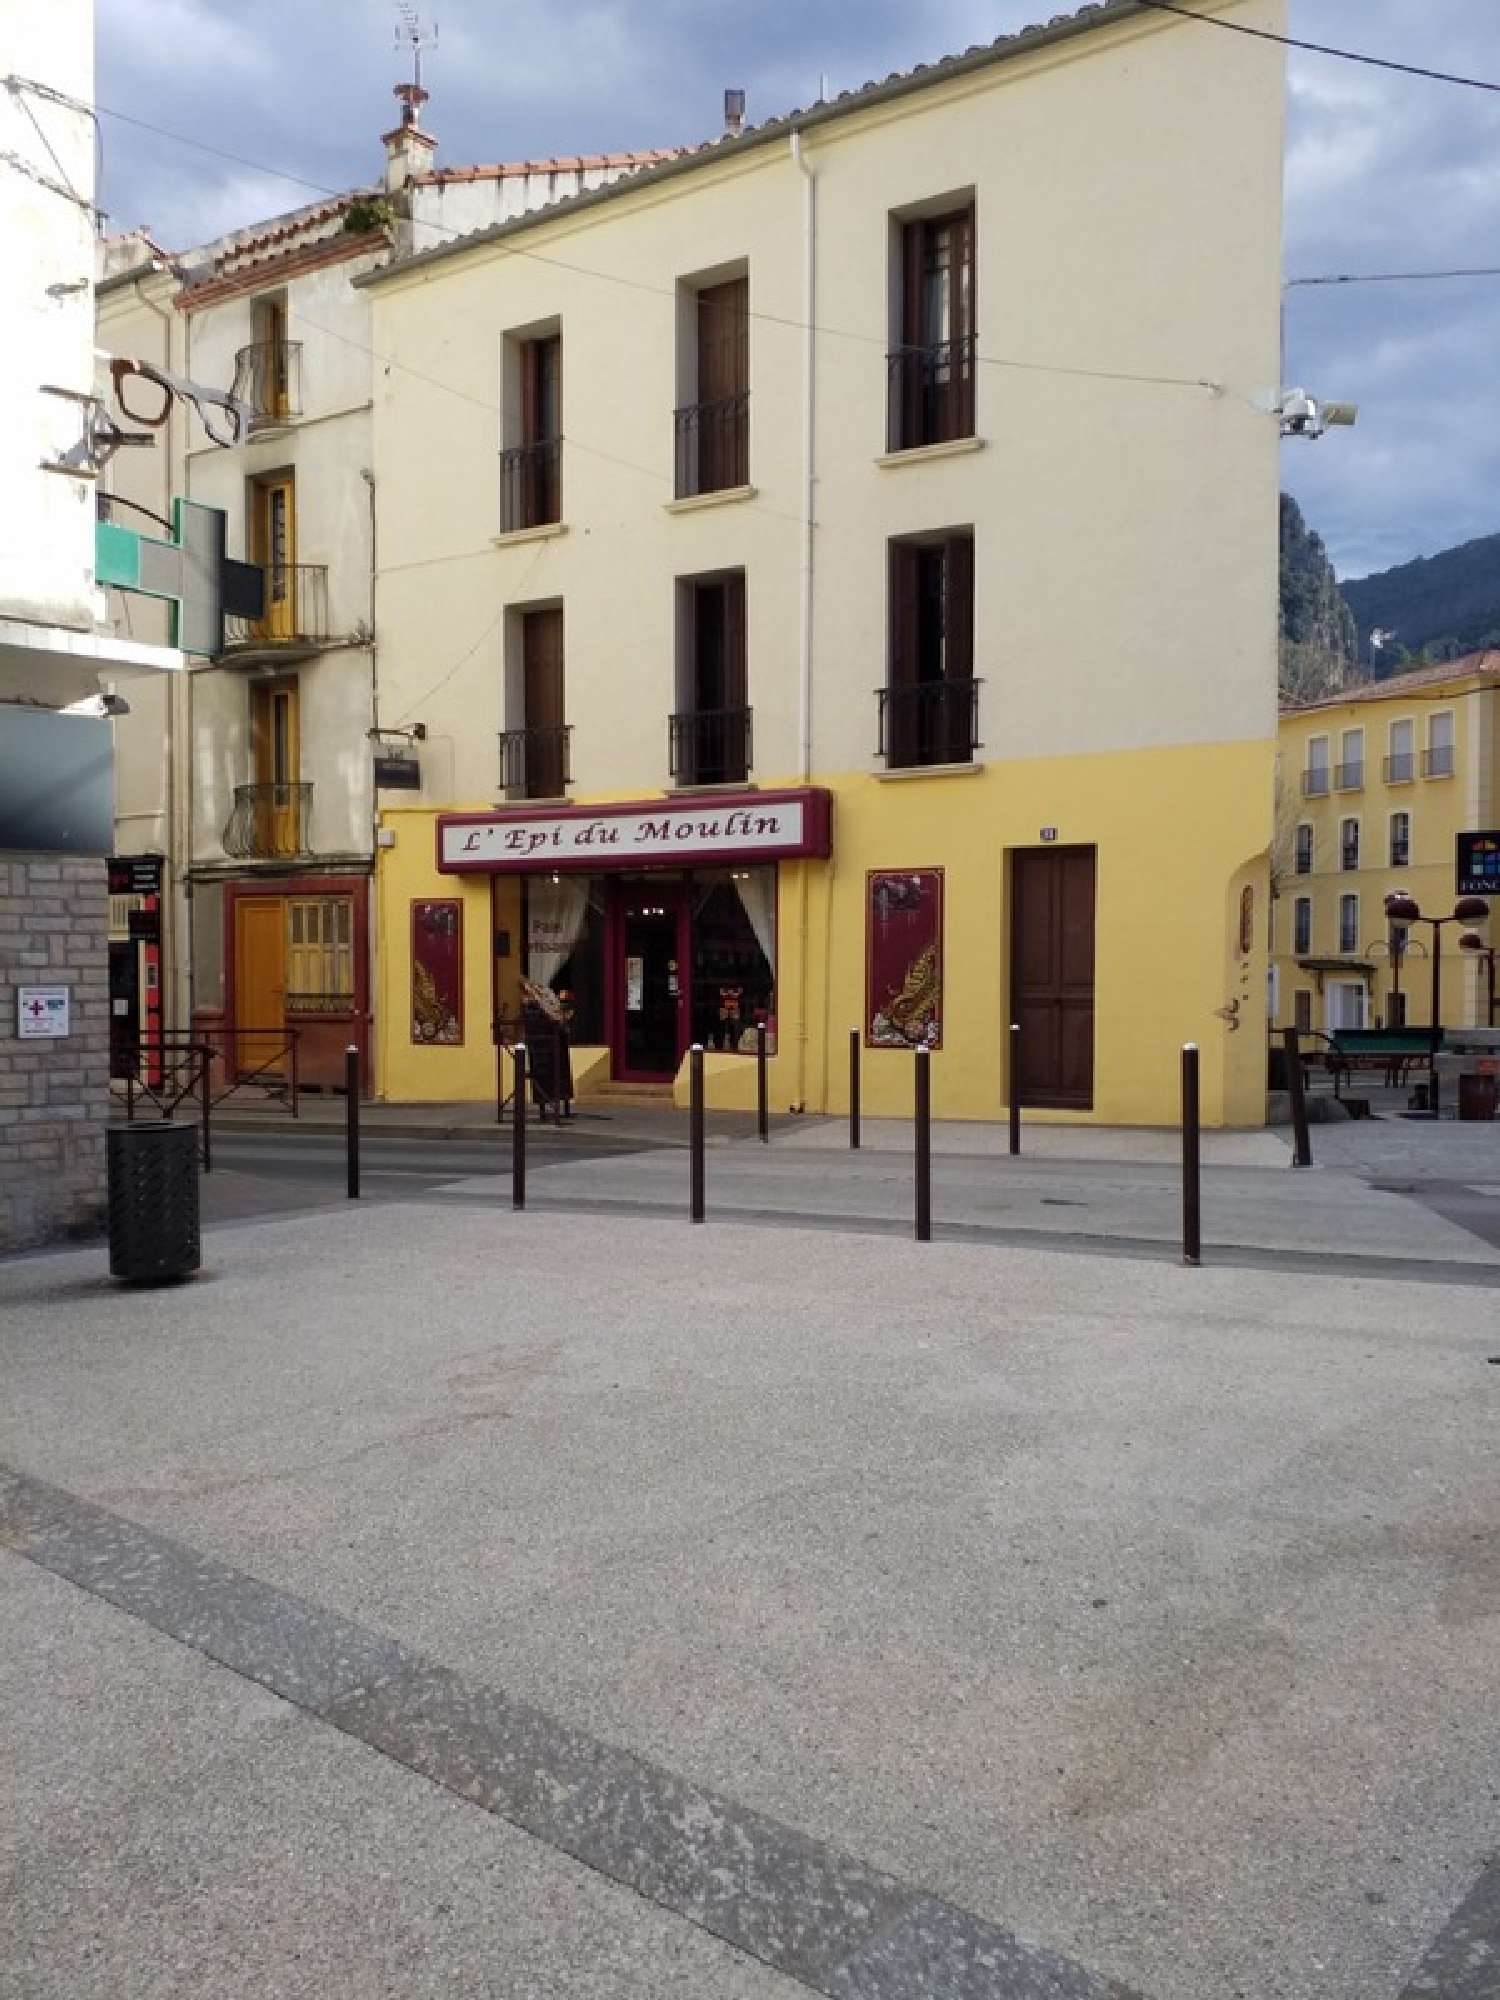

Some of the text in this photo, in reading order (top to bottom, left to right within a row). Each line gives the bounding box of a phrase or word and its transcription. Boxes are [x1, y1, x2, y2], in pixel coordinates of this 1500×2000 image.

[504, 825, 563, 855] Epi
[575, 820, 620, 845] du
[634, 811, 781, 843] Moulin
